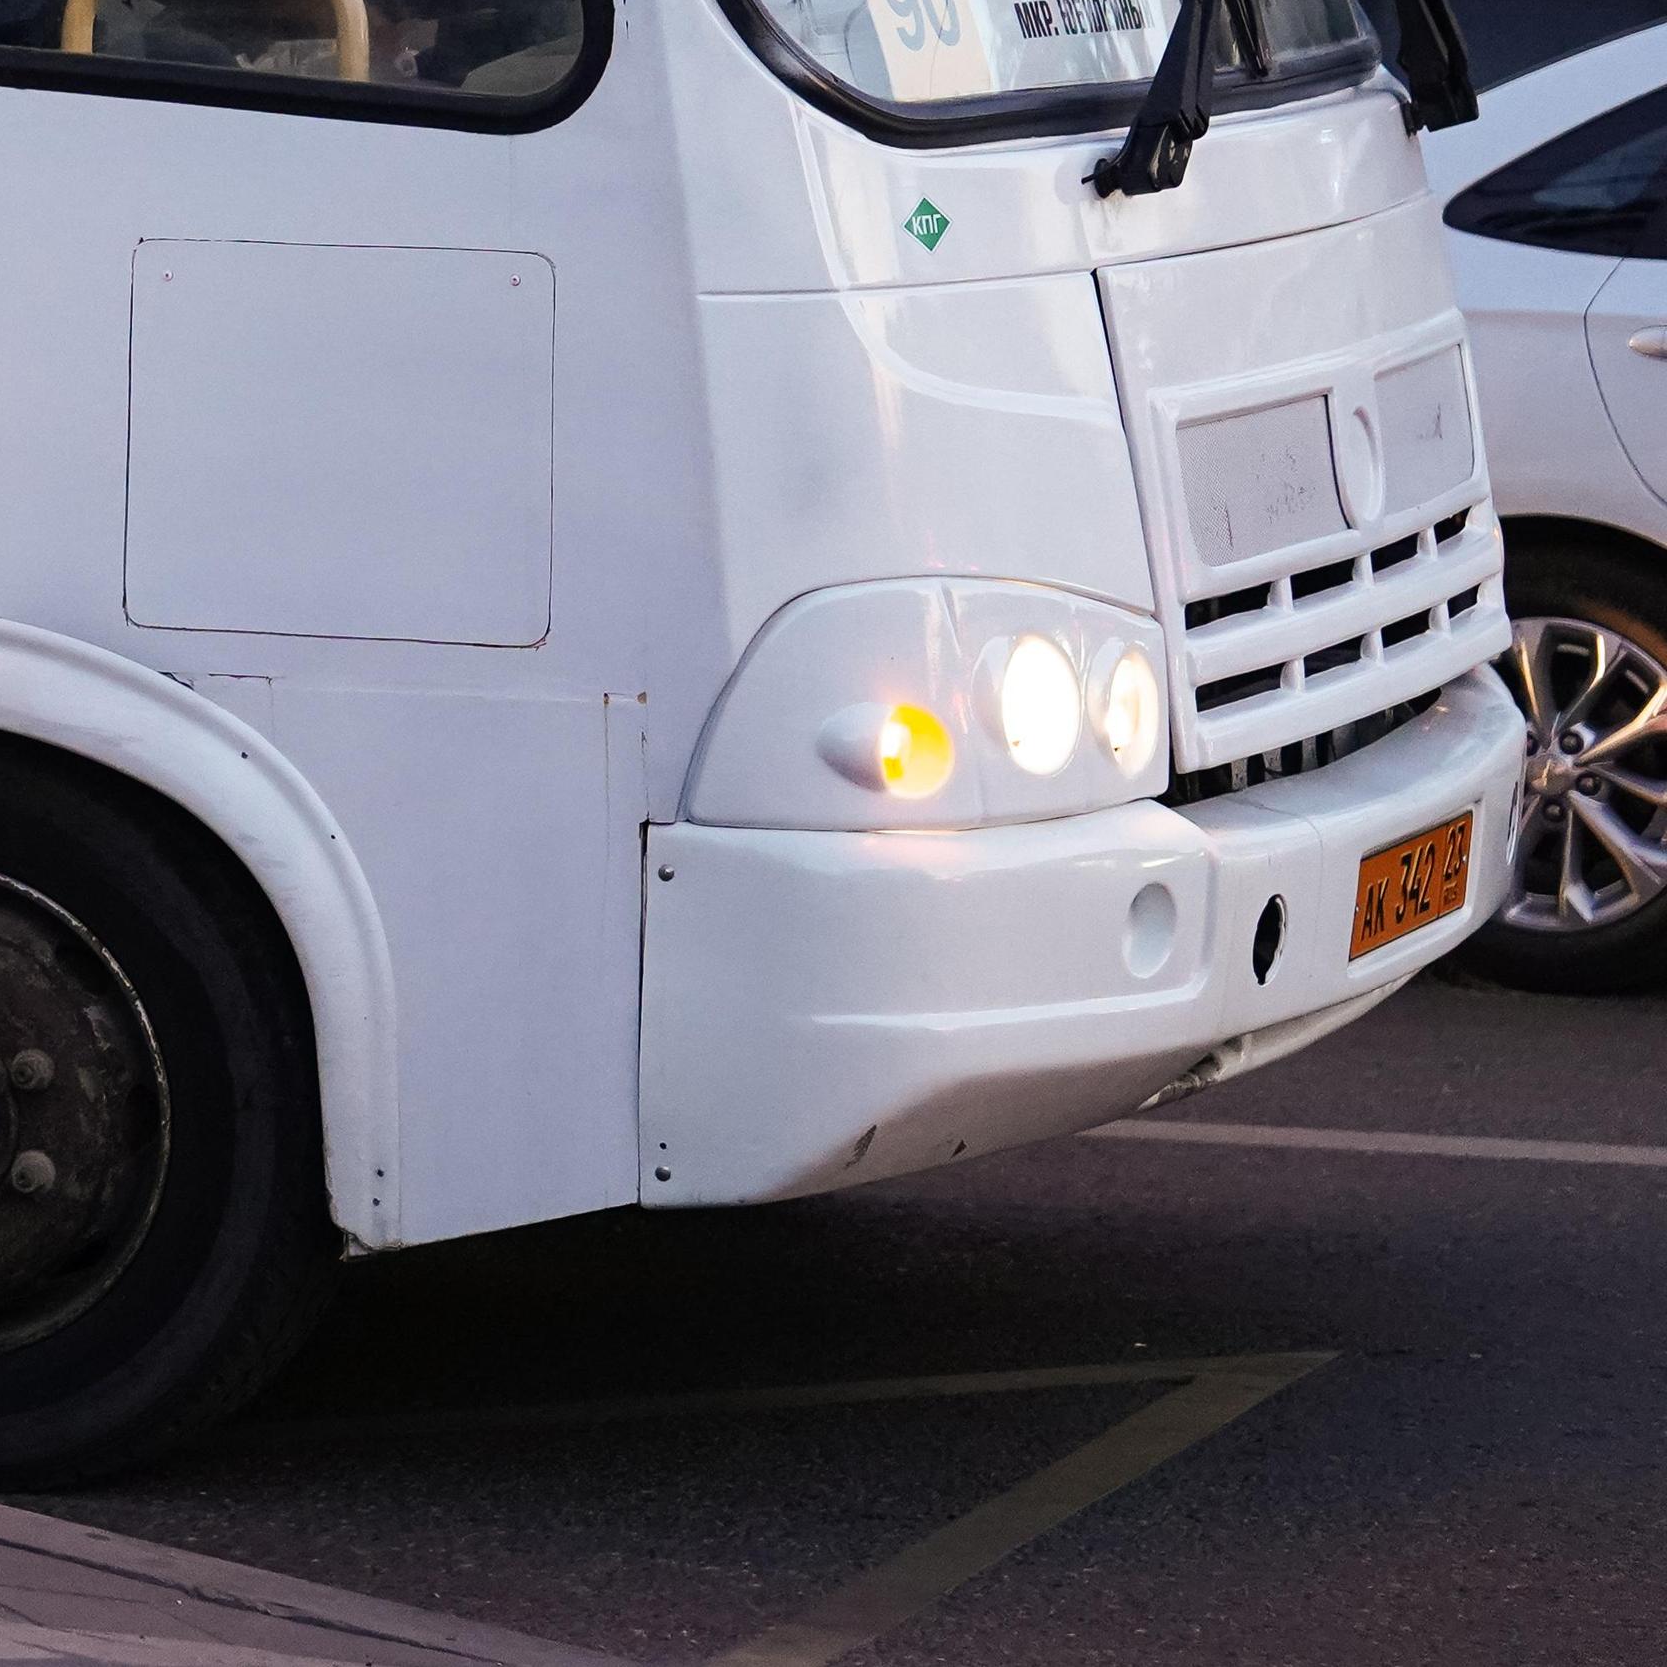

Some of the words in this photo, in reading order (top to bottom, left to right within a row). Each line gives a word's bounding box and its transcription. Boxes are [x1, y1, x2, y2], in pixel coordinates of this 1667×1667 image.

[1013, 0, 1060, 39] МКР.
[911, 212, 942, 236] КПГ
[1443, 820, 1466, 881] 23
[1395, 840, 1436, 925] 342
